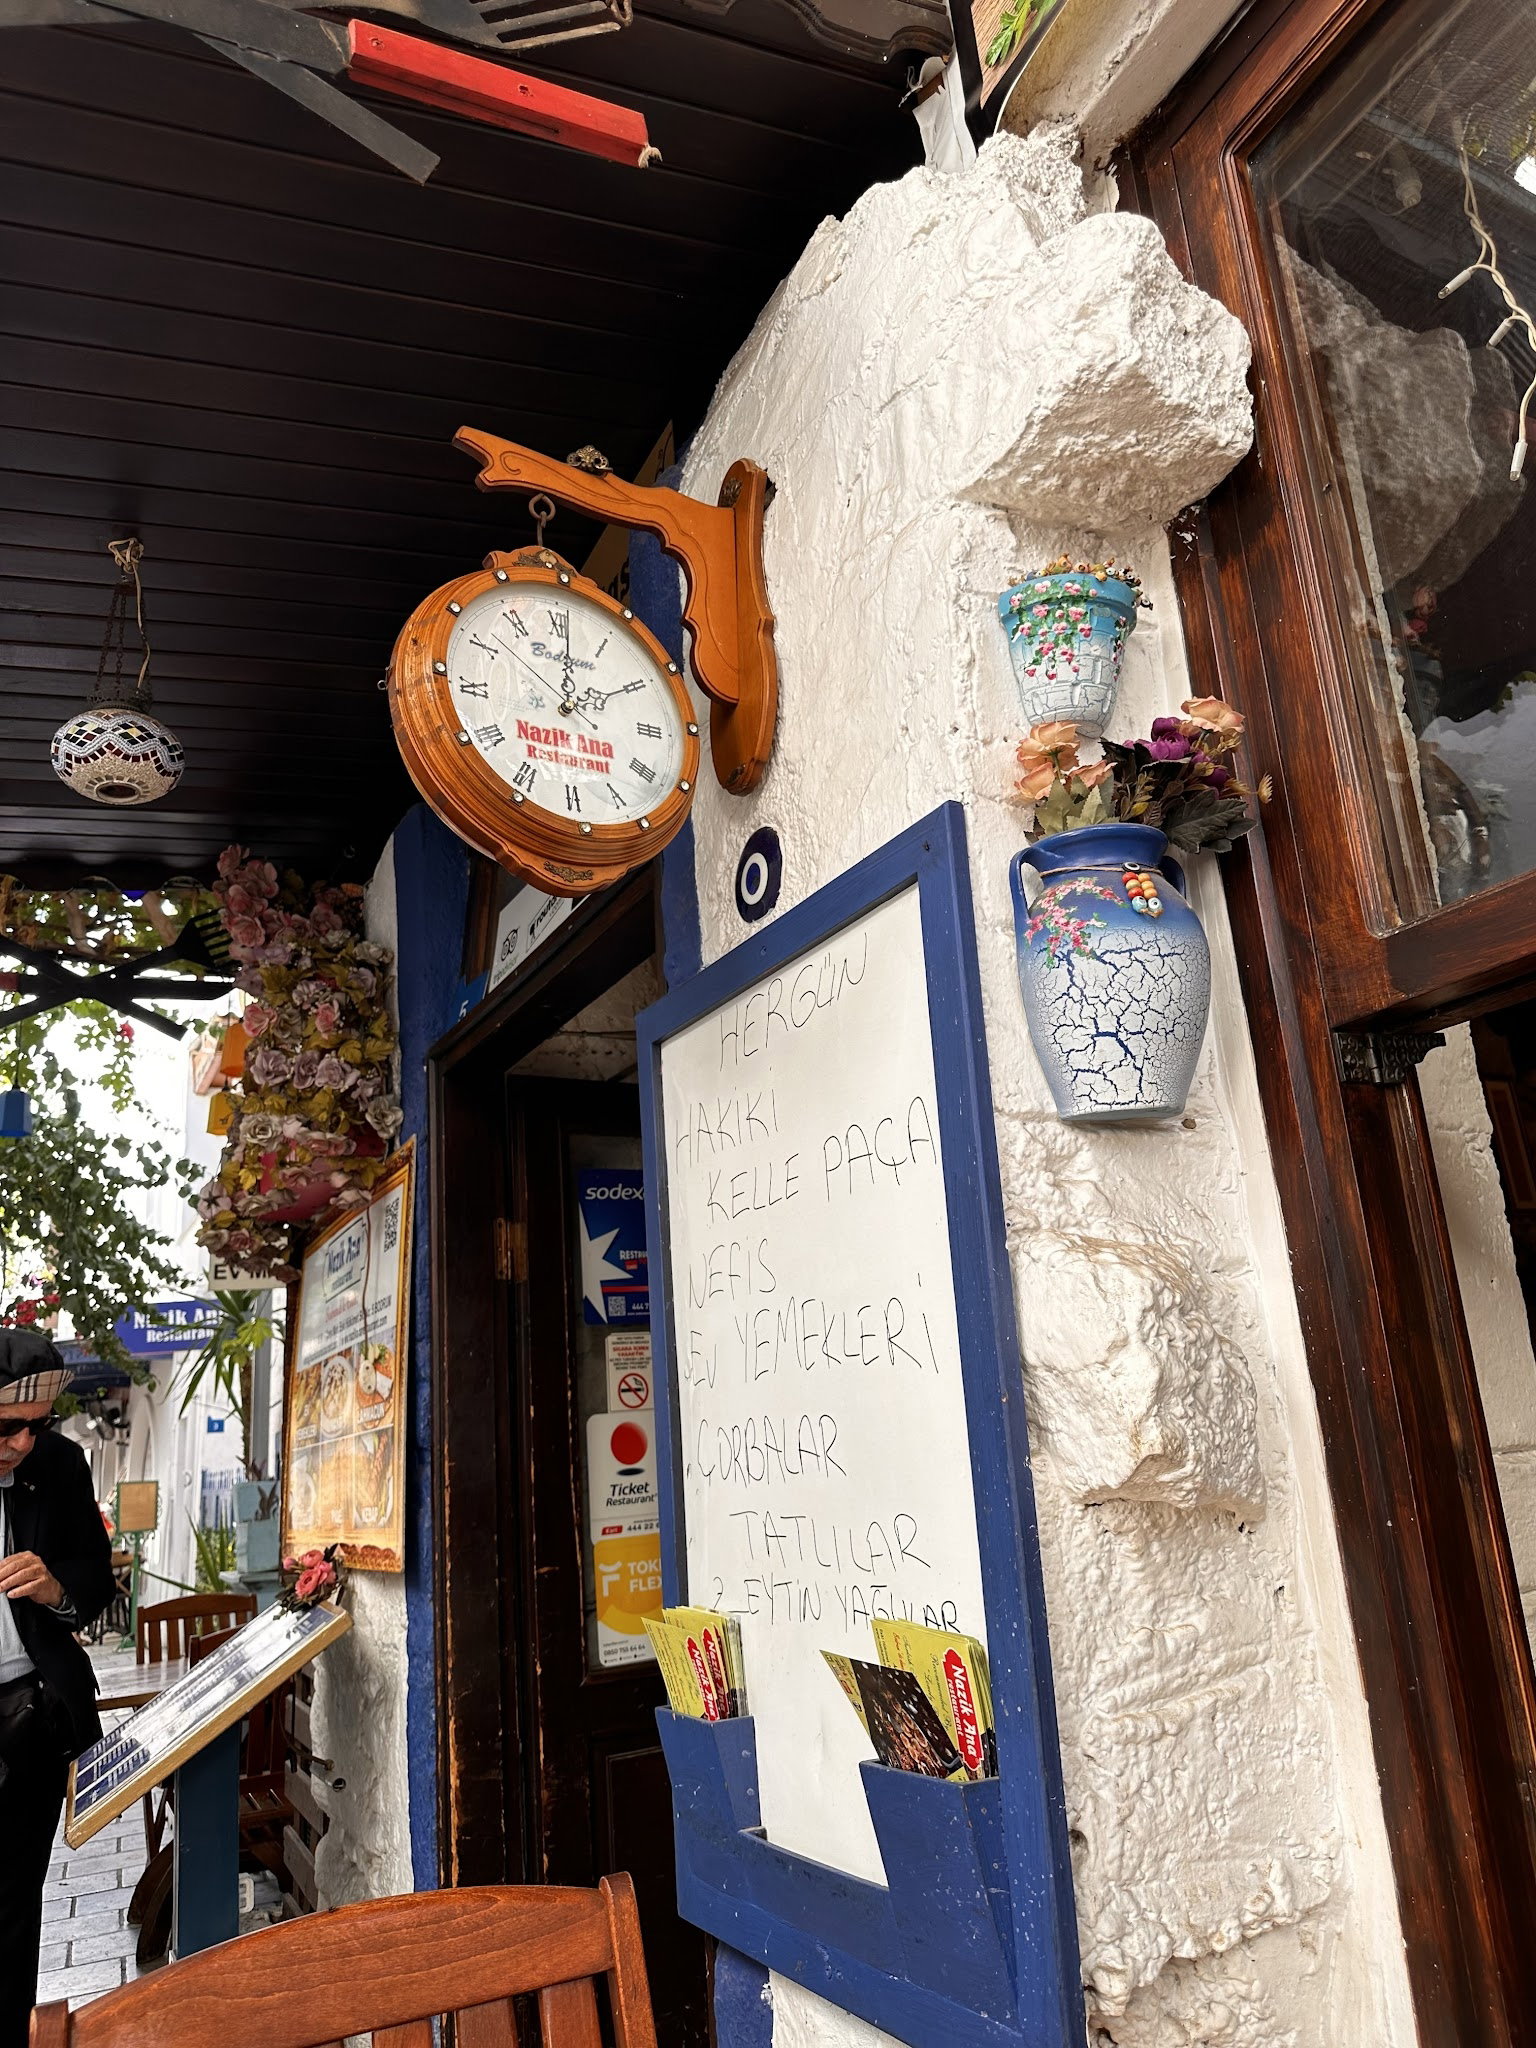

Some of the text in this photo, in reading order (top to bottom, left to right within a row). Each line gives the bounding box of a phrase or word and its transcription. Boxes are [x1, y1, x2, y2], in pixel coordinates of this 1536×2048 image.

[516, 719, 614, 759] Nazik Ana
[526, 743, 610, 774] Restaurant
[719, 932, 867, 1072] HERGÜN
[706, 1096, 937, 1224] KELLE PAÇA
[133, 1309, 188, 1329] Nik
[146, 1328, 217, 1343] Restauran
[605, 1494, 655, 1507] Restaurant
[610, 1481, 650, 1497] Ticket
[729, 1511, 932, 1576] TATLILAR
[692, 1647, 710, 1688] Nazik
[704, 1689, 717, 1717] Ana
[947, 1678, 965, 1737] restaurant
[952, 1664, 978, 1758] Nazik Ana
